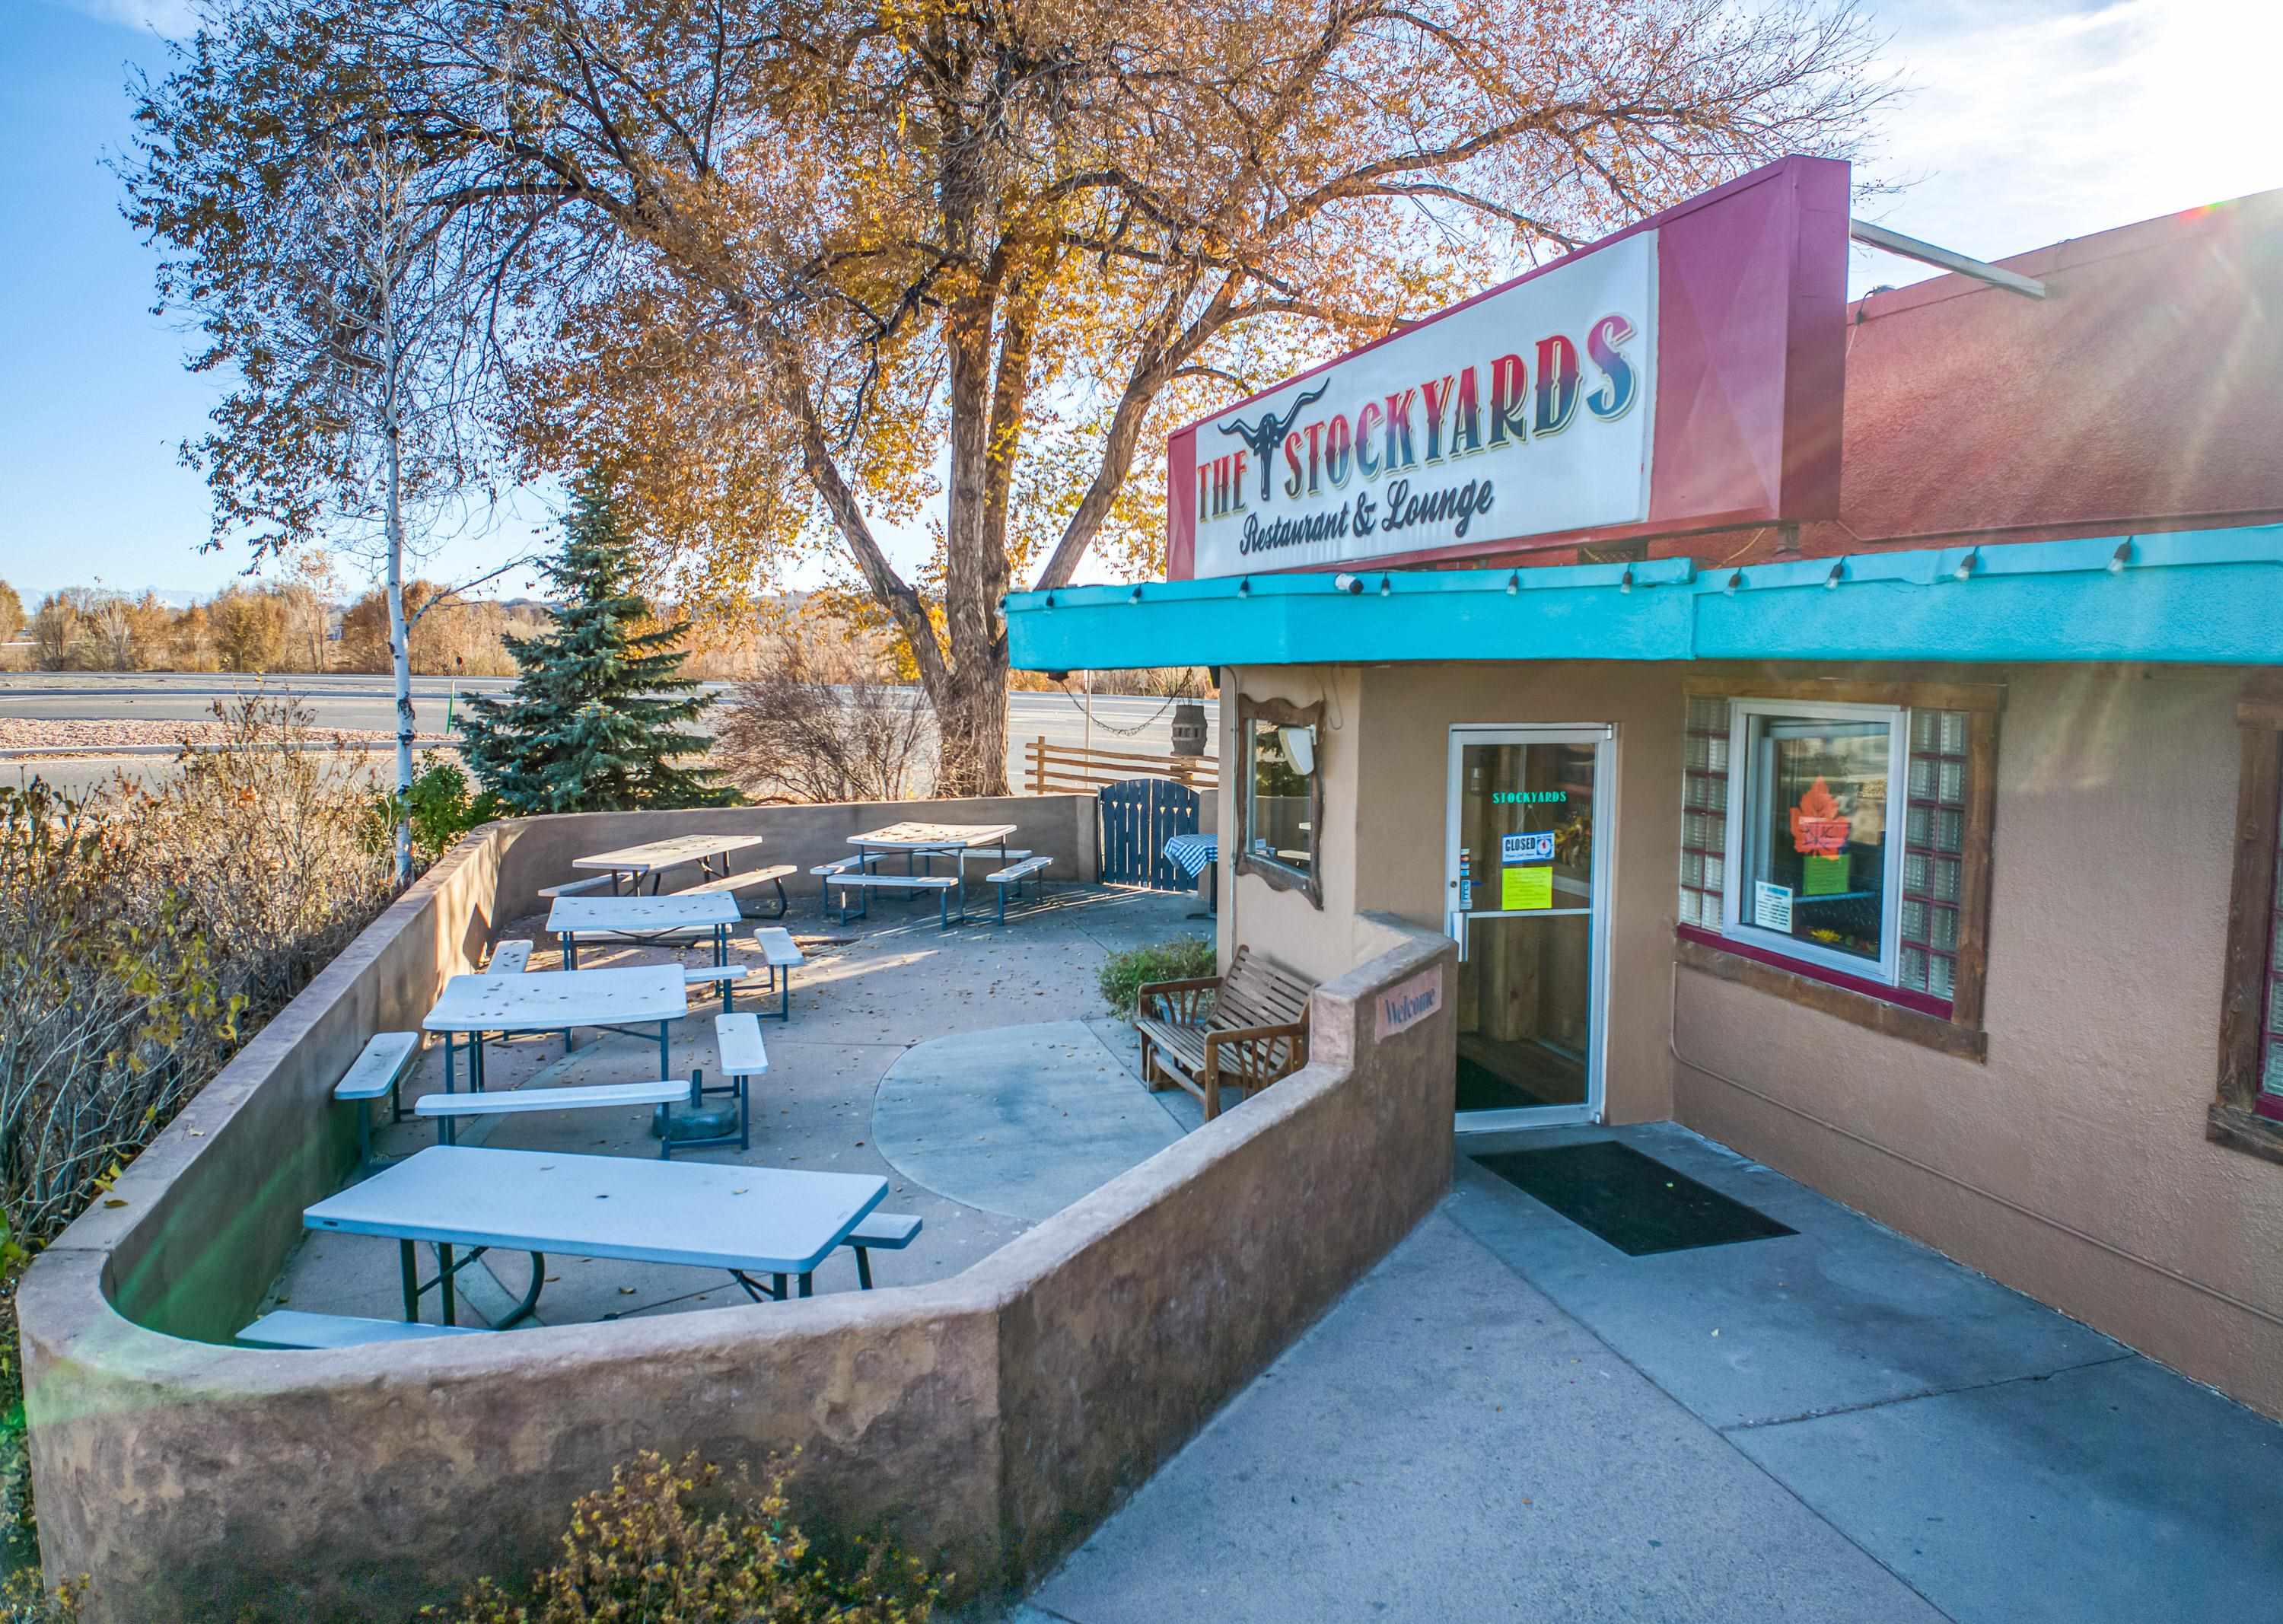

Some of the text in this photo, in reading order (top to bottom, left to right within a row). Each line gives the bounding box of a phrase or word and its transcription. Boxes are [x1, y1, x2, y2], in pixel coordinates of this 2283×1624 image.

[1197, 314, 1637, 523] THE STOCKYARDS
[1240, 479, 1494, 556] Restaurant & Lounge
[1492, 791, 1567, 804] STOCKYARDS
[1505, 837, 1536, 852] CLOSED
[1385, 988, 1435, 1024] Welcome
